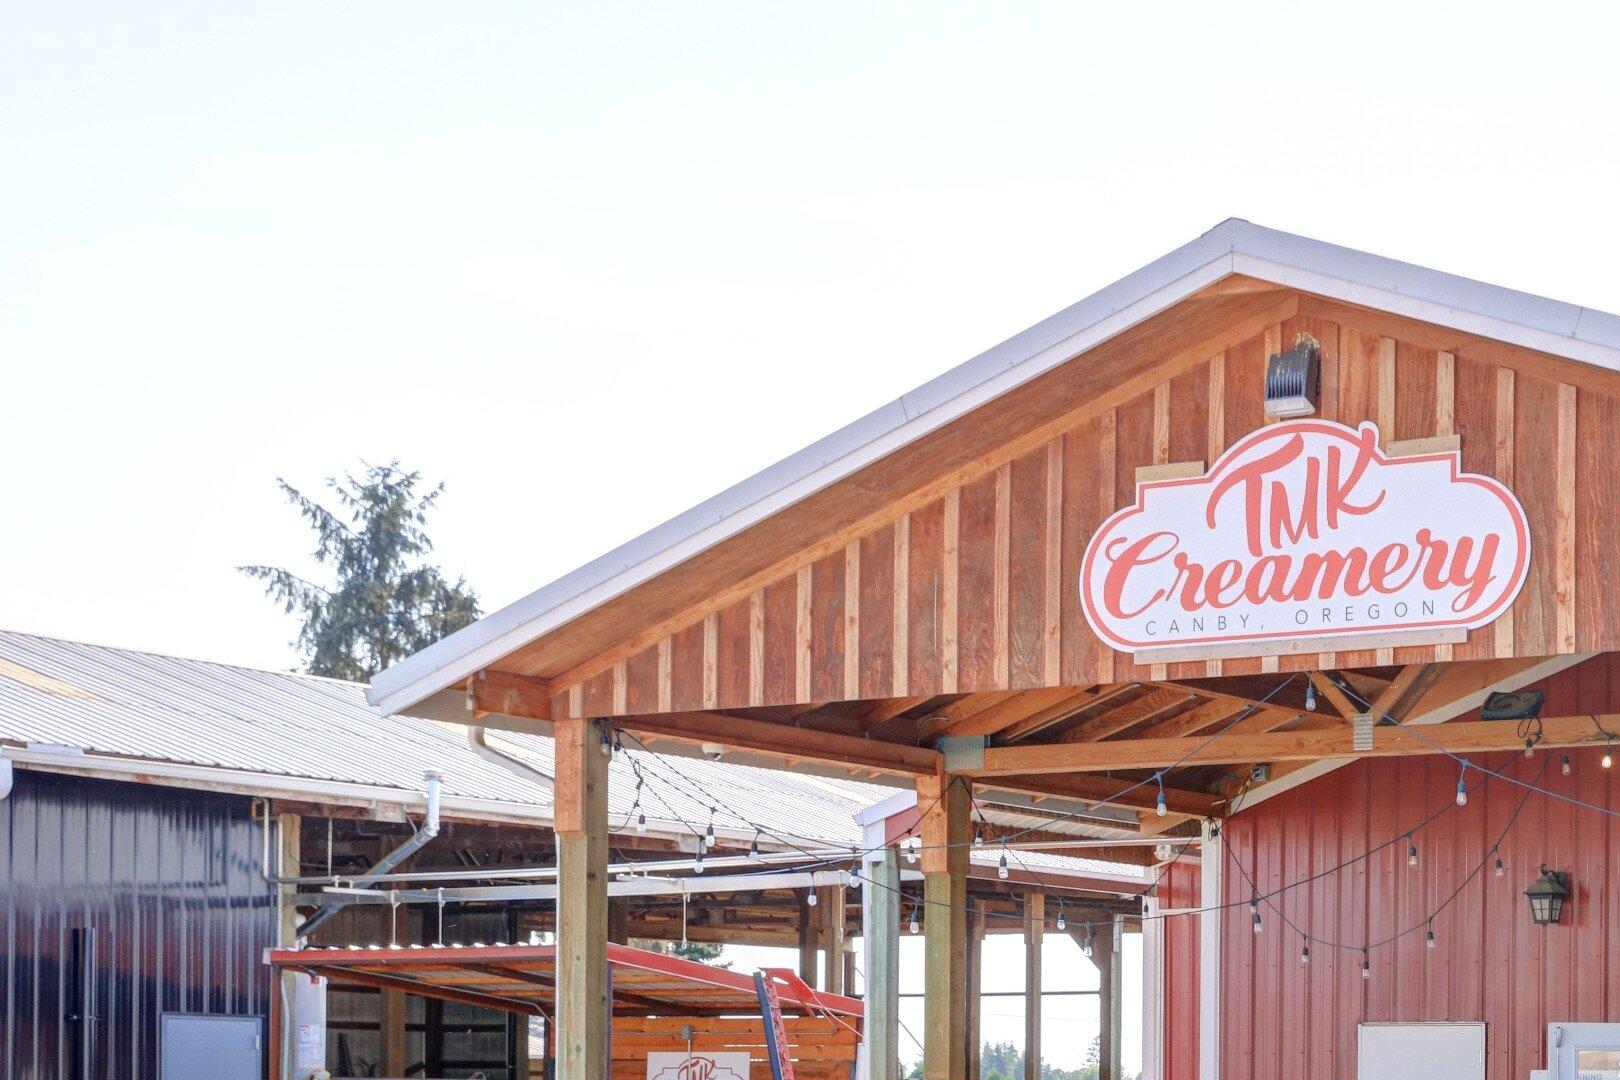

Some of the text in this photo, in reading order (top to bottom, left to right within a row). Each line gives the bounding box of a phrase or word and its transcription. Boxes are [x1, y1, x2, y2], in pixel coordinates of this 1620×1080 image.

[1206, 428, 1386, 557] TMK
[1103, 528, 1500, 620] Creamery
[1145, 600, 1436, 637] CANBY, OREGON
